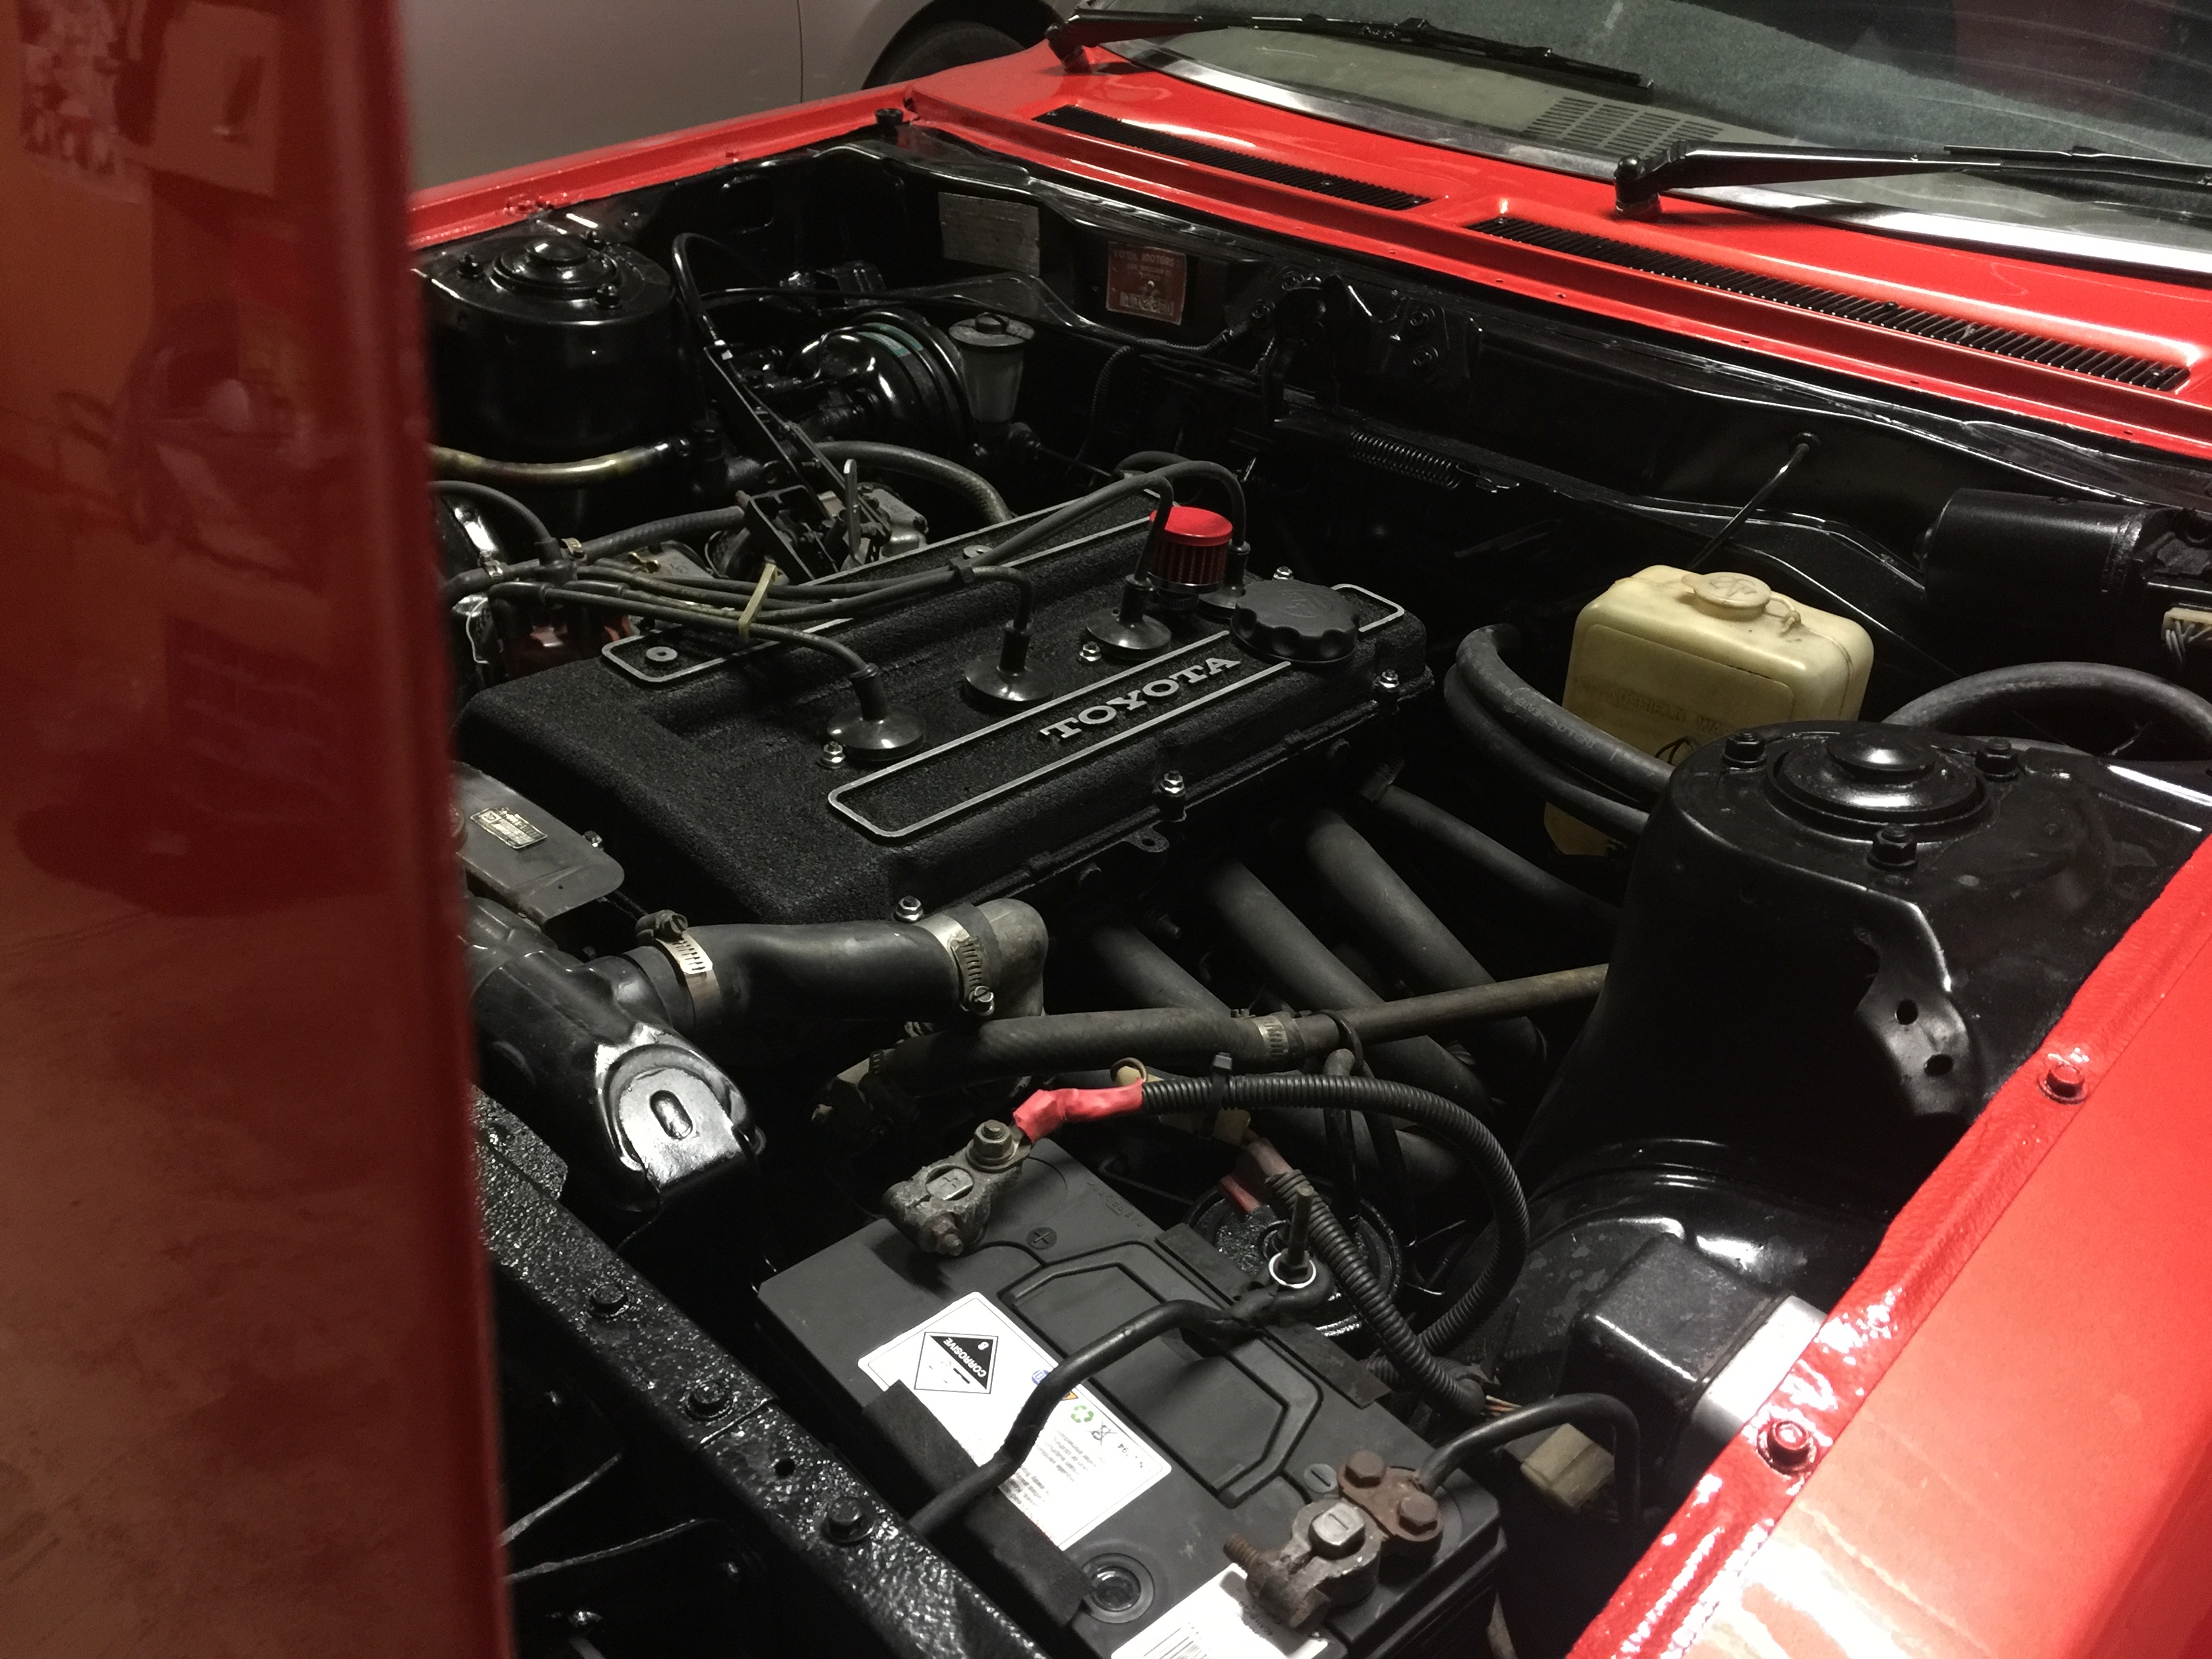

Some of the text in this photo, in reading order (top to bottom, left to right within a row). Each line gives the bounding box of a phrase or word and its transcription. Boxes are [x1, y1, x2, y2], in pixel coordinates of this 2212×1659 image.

[1141, 253, 1174, 267] MOTORS
[1039, 657, 1241, 739] TOYOTA
[977, 1341, 989, 1351] 8
[943, 1337, 987, 1378] CORROSIVE
[1013, 1470, 1031, 1488] away
[1031, 1475, 1045, 1490] away
